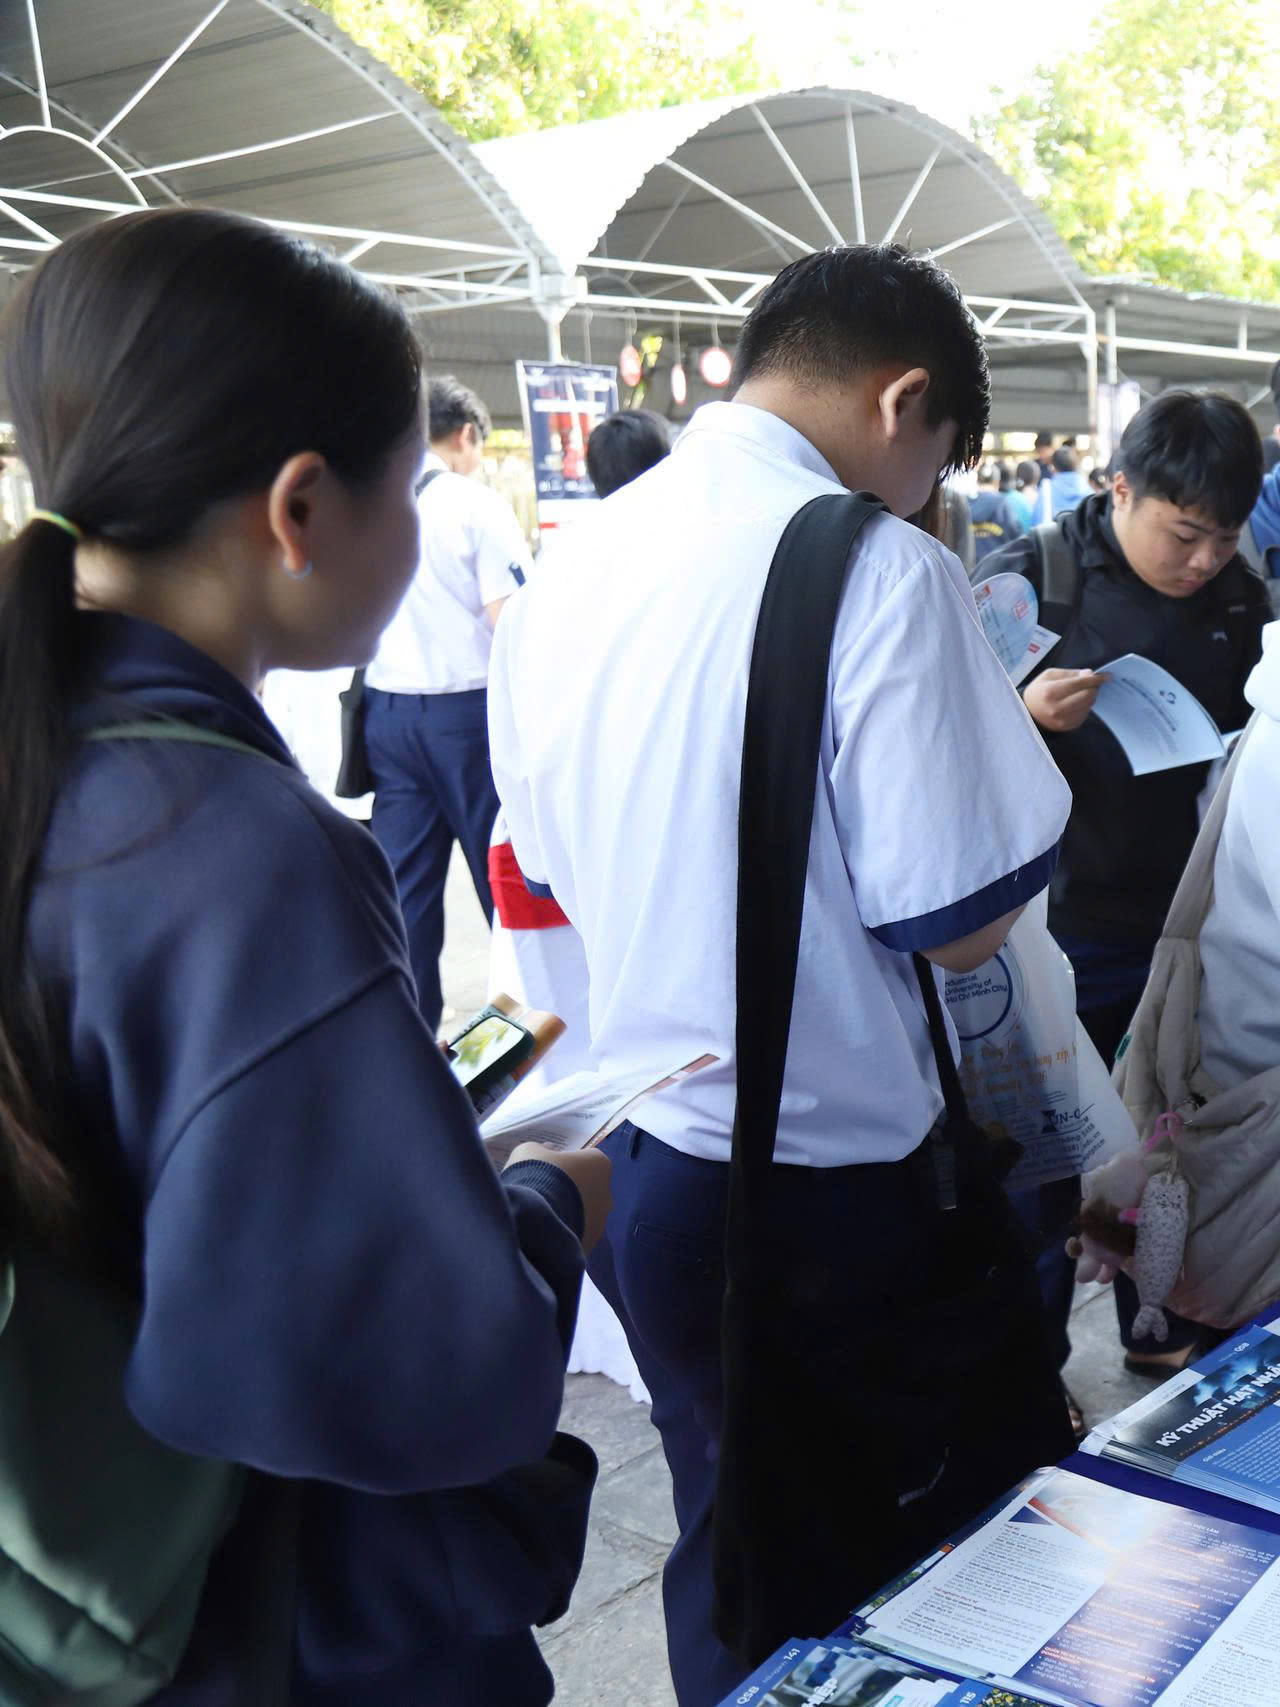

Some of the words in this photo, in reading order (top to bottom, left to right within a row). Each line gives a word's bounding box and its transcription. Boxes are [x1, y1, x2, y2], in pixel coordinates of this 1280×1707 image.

[945, 974, 978, 988] ndustrial
[1155, 1431, 1181, 1447] KỸ
[1175, 1402, 1229, 1435] THUẬT
[1223, 1384, 1257, 1406] HẠT
[737, 1686, 760, 1704] QSB
[784, 1648, 800, 1660] 141
[960, 1691, 977, 1704] 115
